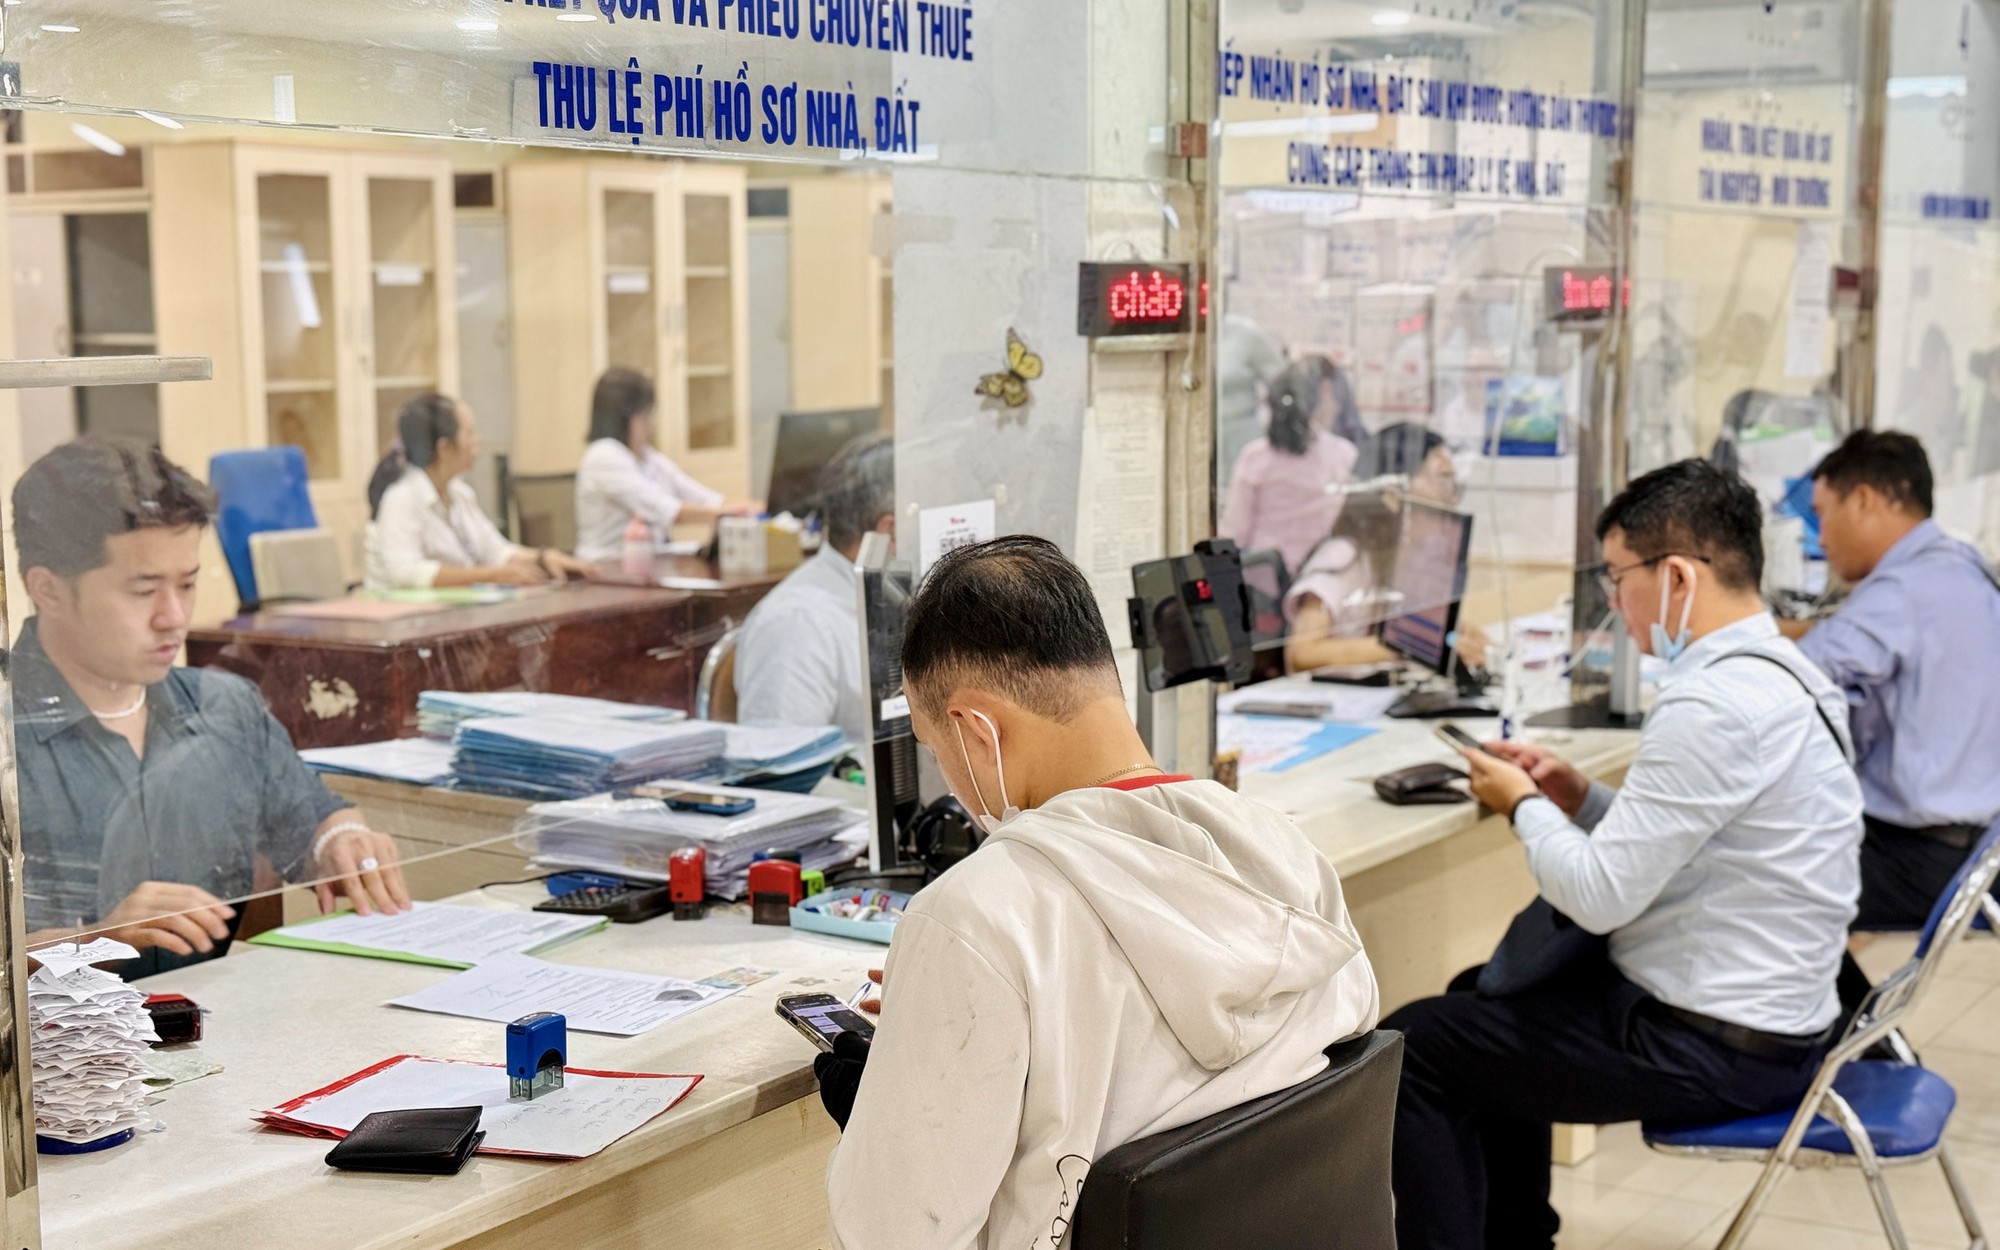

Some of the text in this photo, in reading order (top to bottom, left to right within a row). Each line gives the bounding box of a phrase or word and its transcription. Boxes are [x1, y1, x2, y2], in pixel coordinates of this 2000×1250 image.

[532, 57, 920, 158] THU LỆ PHÍ HỒ SƠ NHÀ, ĐẤT
[1110, 271, 1182, 318] chào
